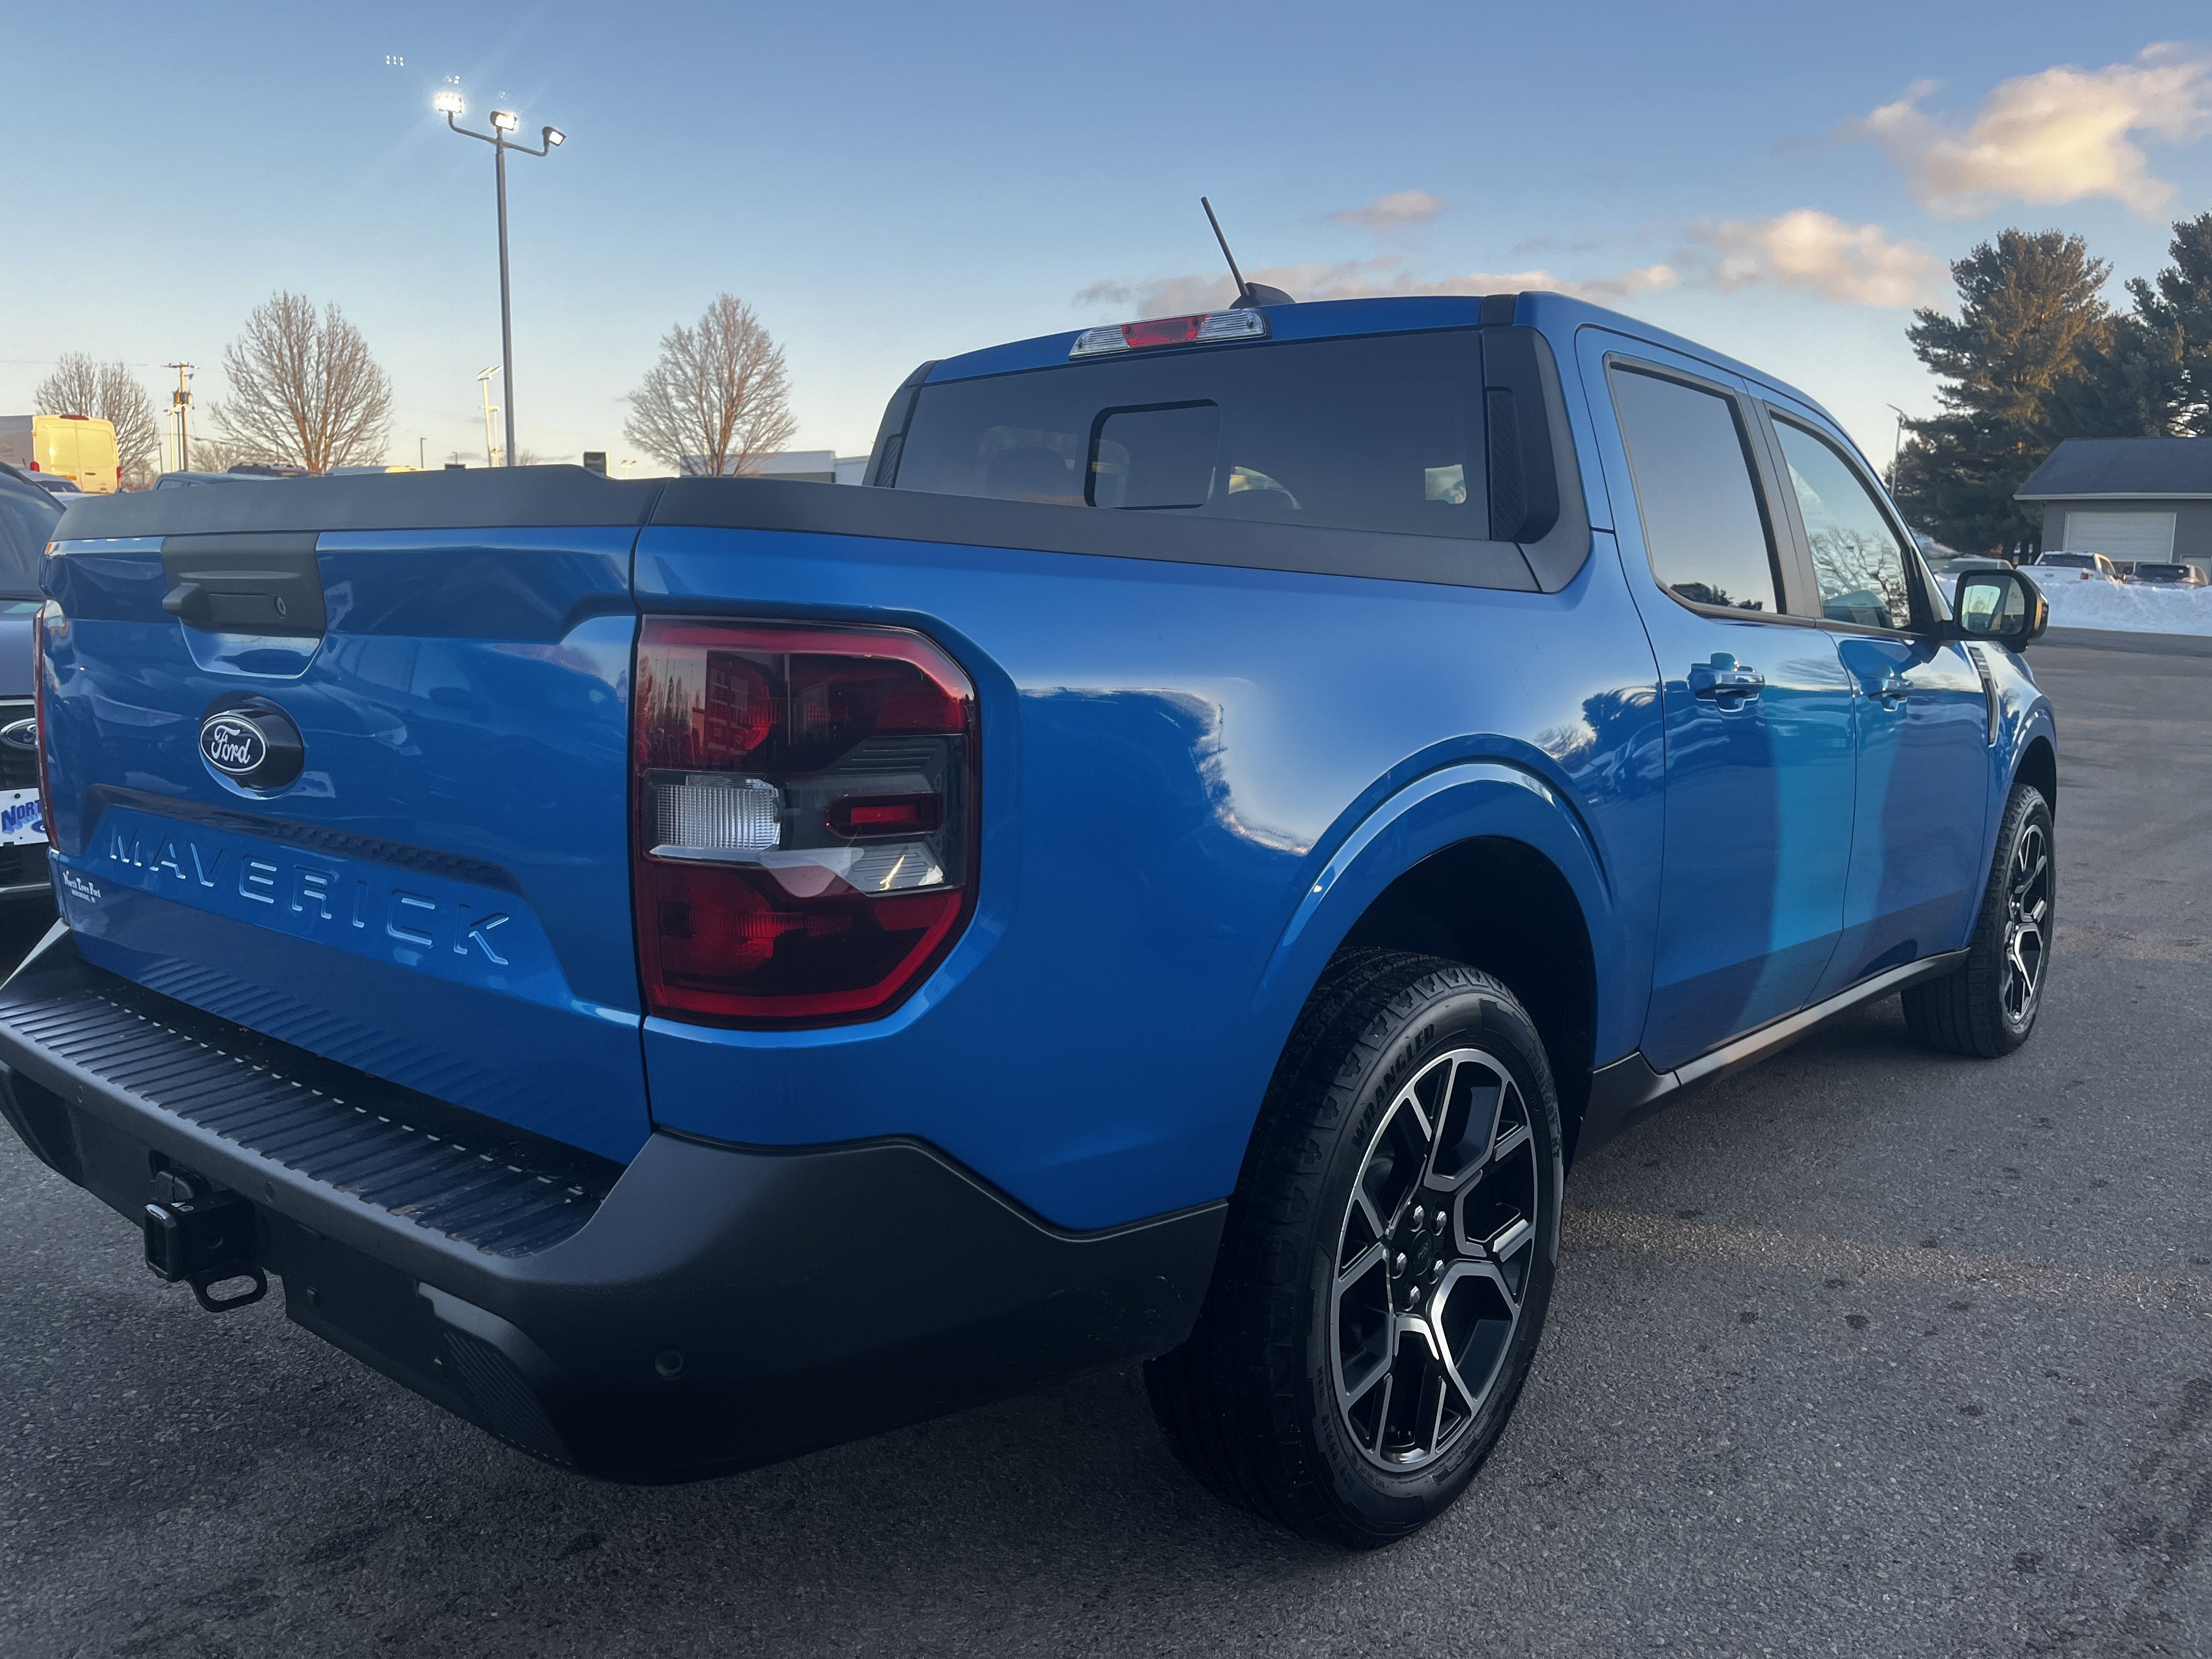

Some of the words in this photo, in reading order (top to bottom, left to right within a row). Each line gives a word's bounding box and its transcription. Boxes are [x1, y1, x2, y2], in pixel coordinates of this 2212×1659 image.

[211, 725, 250, 763] Ford
[110, 825, 509, 965] MAVERICK
[1351, 1023, 1435, 1148] WRANGLER
